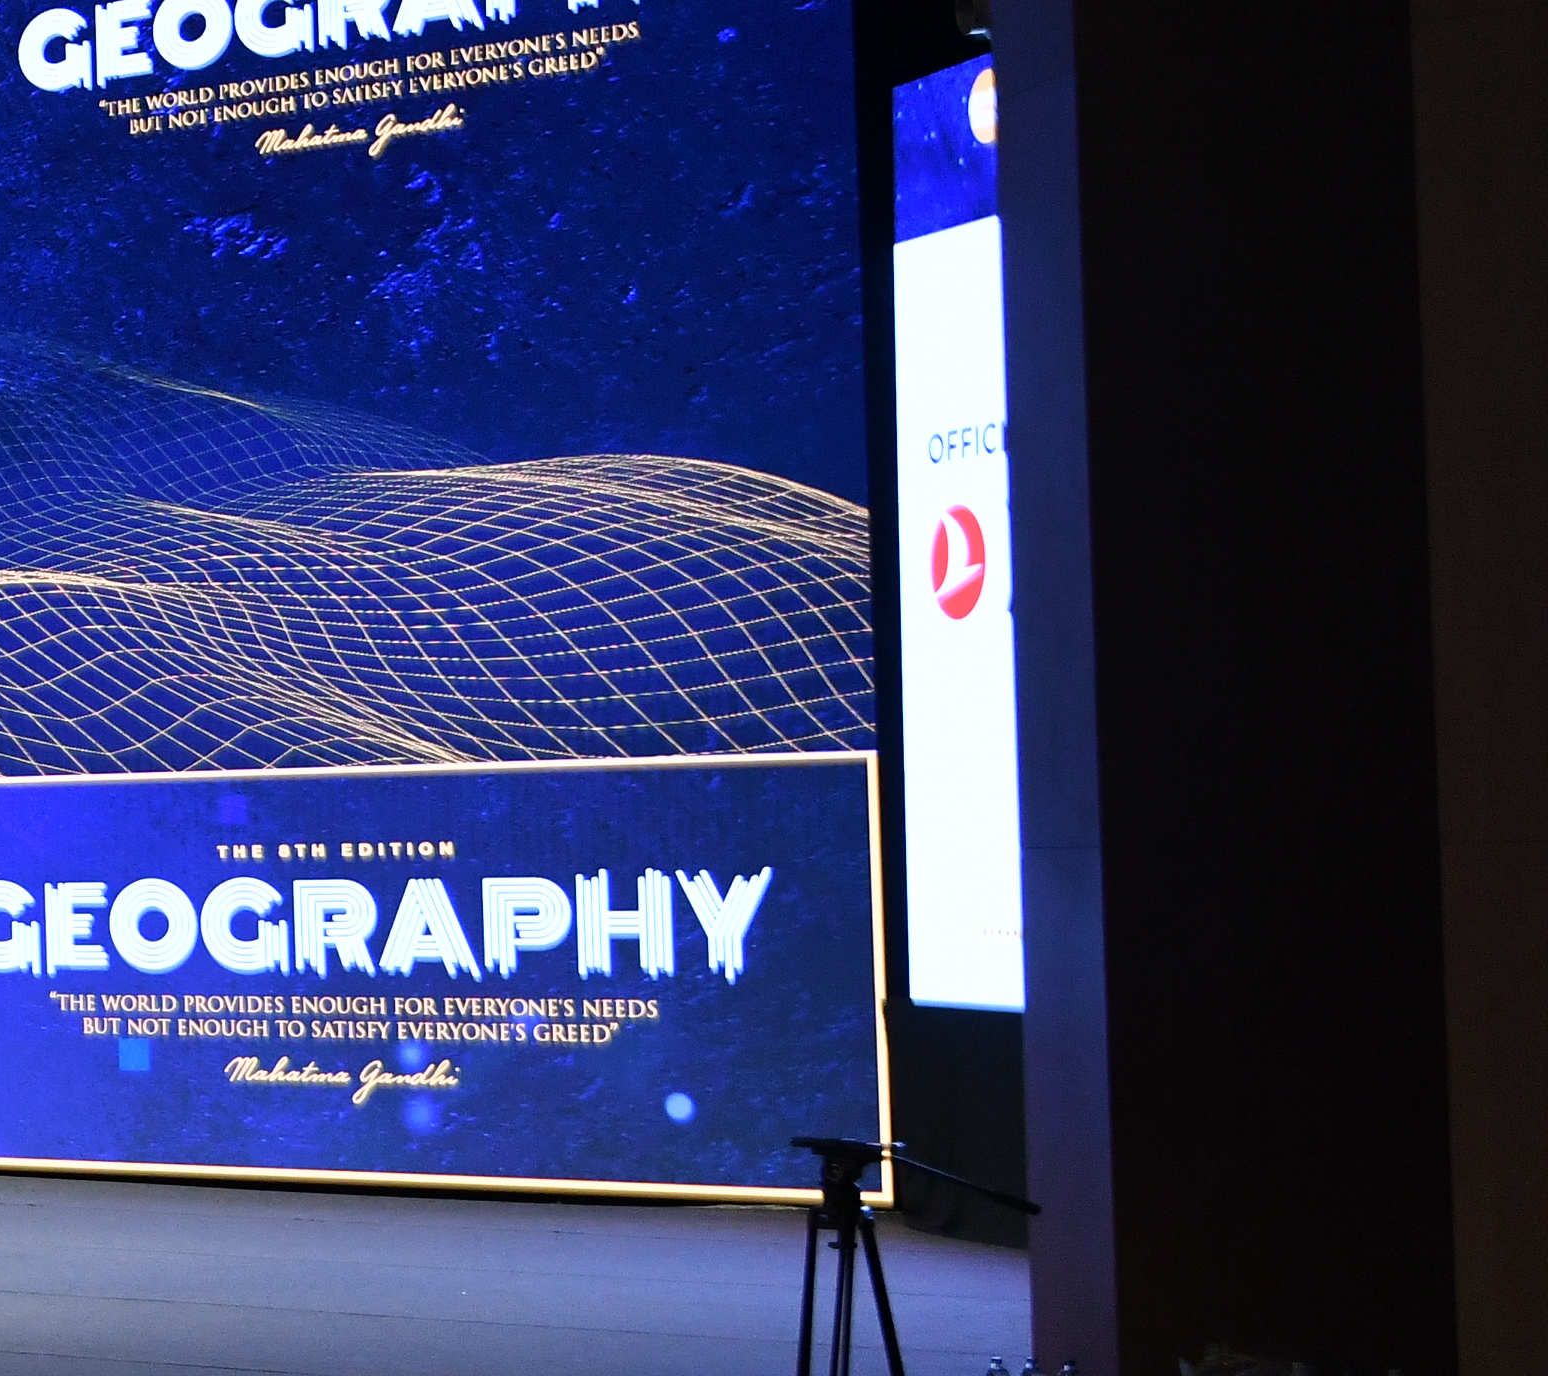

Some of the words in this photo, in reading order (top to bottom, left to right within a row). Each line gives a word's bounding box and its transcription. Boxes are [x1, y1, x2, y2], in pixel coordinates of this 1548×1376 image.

[145, 87, 214, 110] WORLD
[219, 72, 309, 99] PROVIDES
[315, 57, 400, 86] ENOUGH
[406, 52, 445, 73] FOR
[450, 32, 565, 65] EVERYONE'S
[572, 21, 640, 48] NEEDS
[130, 116, 162, 135] BUT
[168, 109, 208, 130] NOT
[214, 96, 295, 123] ENOUGH
[303, 91, 327, 110] TO
[332, 79, 403, 105] SATISFY
[409, 62, 523, 95] EVERYONE'S
[255, 124, 367, 155] Mahatma
[369, 103, 465, 157] Gandhi
[217, 841, 268, 860] THE
[277, 840, 331, 860] 8TH
[341, 840, 456, 860] EDITION
[83, 1017, 120, 1035] BUT
[127, 1018, 171, 1036] NOT
[178, 1018, 268, 1037] ENOUGH
[275, 1020, 305, 1038] TO
[311, 1020, 390, 1039] SATISFY
[397, 1022, 526, 1042] EVERYONE'S
[101, 994, 177, 1013] WORLD
[184, 995, 284, 1014] PROVIDES
[291, 996, 387, 1015] ENOUGH
[393, 997, 438, 1016] FOR
[444, 998, 574, 1018] EVERYONE'S
[582, 999, 658, 1019] NEEDS
[224, 1056, 350, 1083] Mahatma
[352, 1059, 460, 1105] Gandhi
